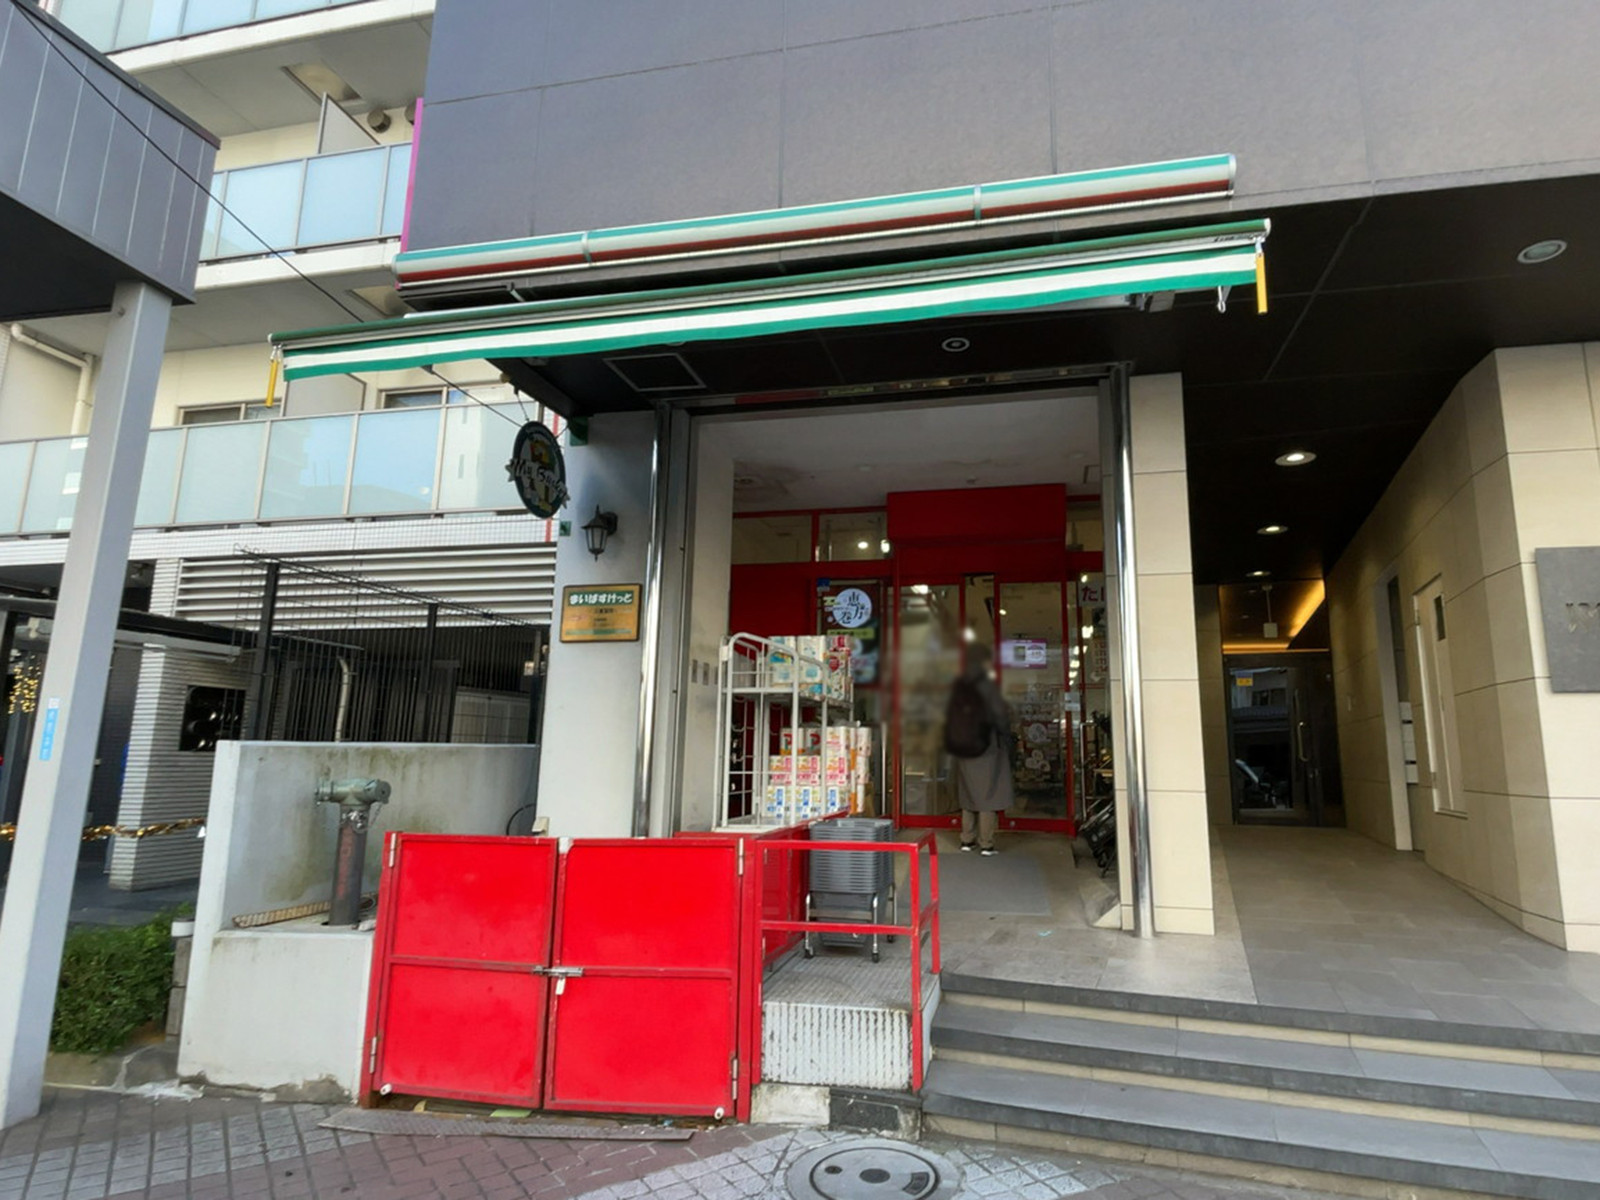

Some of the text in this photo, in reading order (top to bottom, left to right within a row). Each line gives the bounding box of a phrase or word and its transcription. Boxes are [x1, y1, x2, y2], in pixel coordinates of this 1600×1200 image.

[569, 592, 633, 606] まいばすけっと
